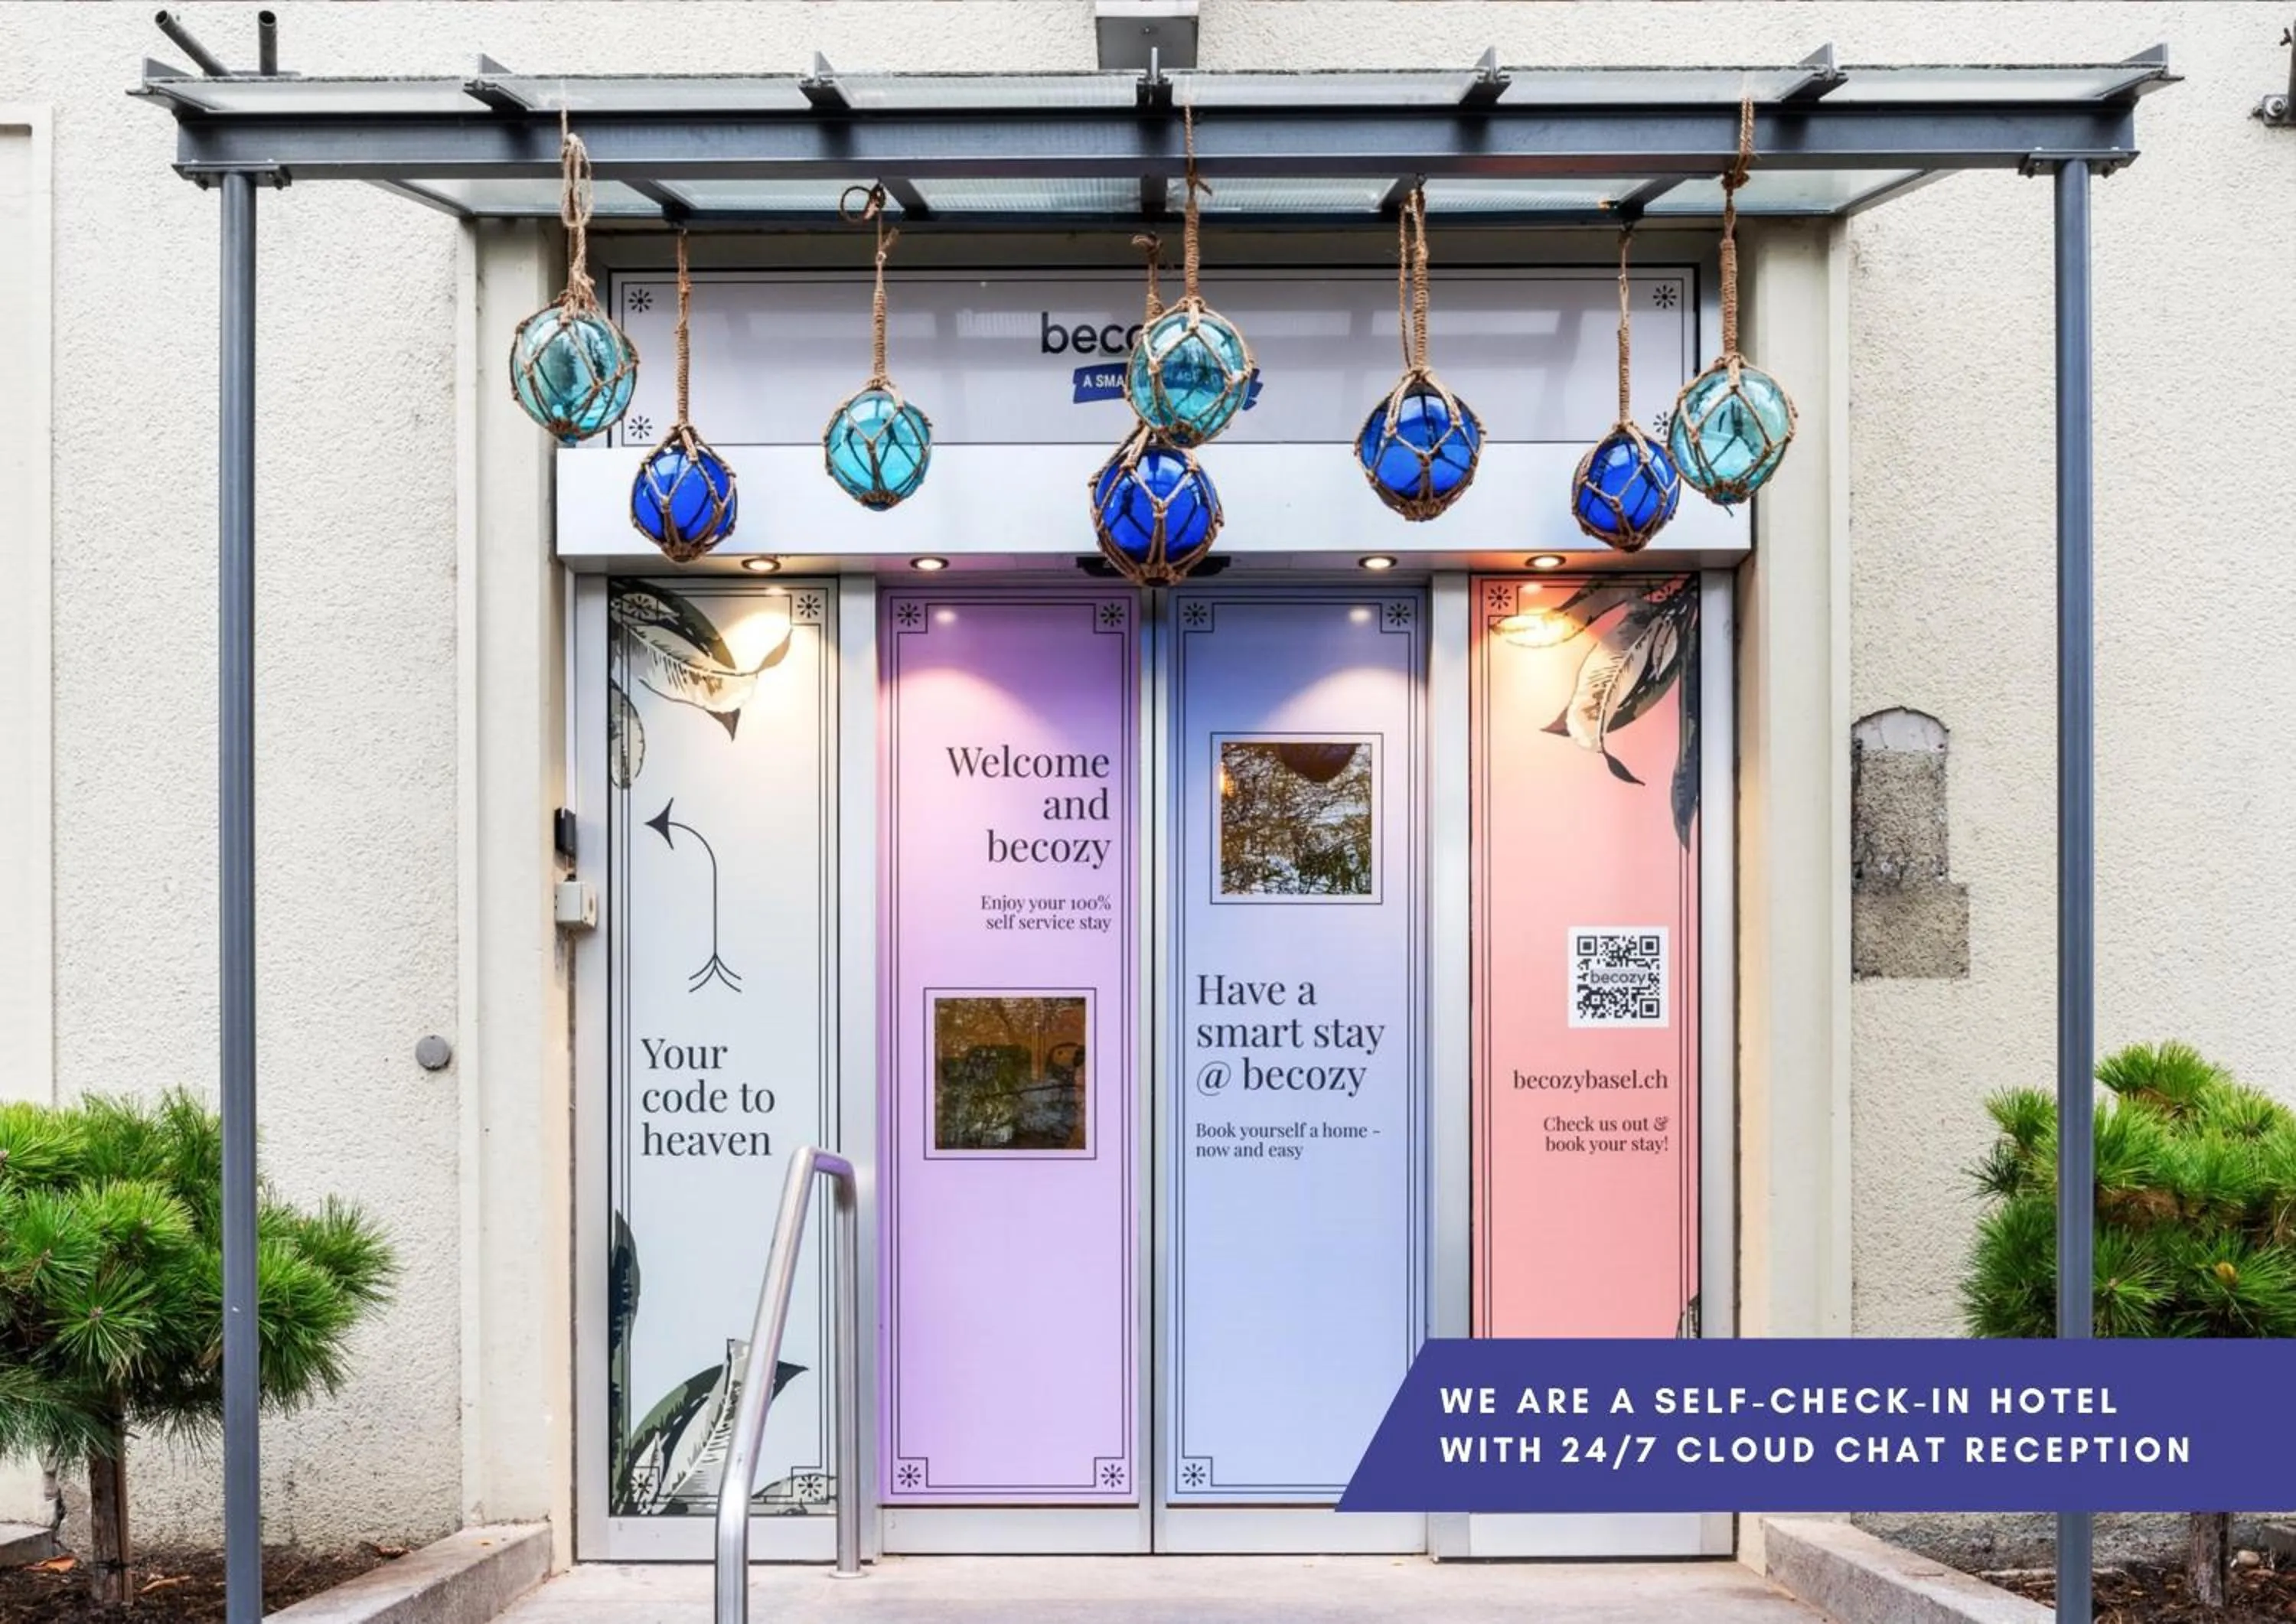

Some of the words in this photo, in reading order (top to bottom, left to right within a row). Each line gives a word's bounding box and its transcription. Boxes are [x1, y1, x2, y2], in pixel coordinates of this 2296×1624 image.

[1083, 374, 1093, 388] A
[1096, 373, 1125, 388] SMA
[947, 744, 1110, 778] Welcome
[1043, 787, 1110, 820] and
[987, 829, 1112, 870] becozy
[981, 895, 1025, 913] Enjoy
[1029, 898, 1066, 913] your
[1071, 895, 1111, 911] 100%
[986, 914, 1016, 930] self
[1019, 915, 1075, 930] service
[1079, 916, 1112, 934] stay
[1197, 974, 1286, 1006] Have
[1297, 981, 1318, 1006] a
[1590, 970, 1646, 985] becozy
[1197, 1019, 1304, 1048] smart
[1313, 1019, 1385, 1055] stay
[641, 1038, 729, 1071] Your
[1196, 1060, 1231, 1097] @
[1241, 1056, 1368, 1098] becozy
[1513, 1069, 1668, 1093] becozybasel.ch
[641, 1078, 729, 1114] code
[739, 1082, 775, 1114] to
[1195, 1121, 1237, 1139] Book
[1239, 1121, 1307, 1140] yourself
[1309, 1128, 1319, 1139] a
[1322, 1121, 1368, 1139] home
[1543, 1115, 1595, 1132] Check
[1599, 1120, 1618, 1132] us
[1621, 1117, 1649, 1132] out
[1653, 1116, 1669, 1131] &
[641, 1121, 773, 1157] heaven
[1195, 1143, 1231, 1158] now
[1233, 1141, 1264, 1158] and
[1267, 1145, 1304, 1161] easy
[1545, 1136, 1585, 1152] book
[1589, 1140, 1628, 1155] your
[1631, 1136, 1668, 1155] stay!
